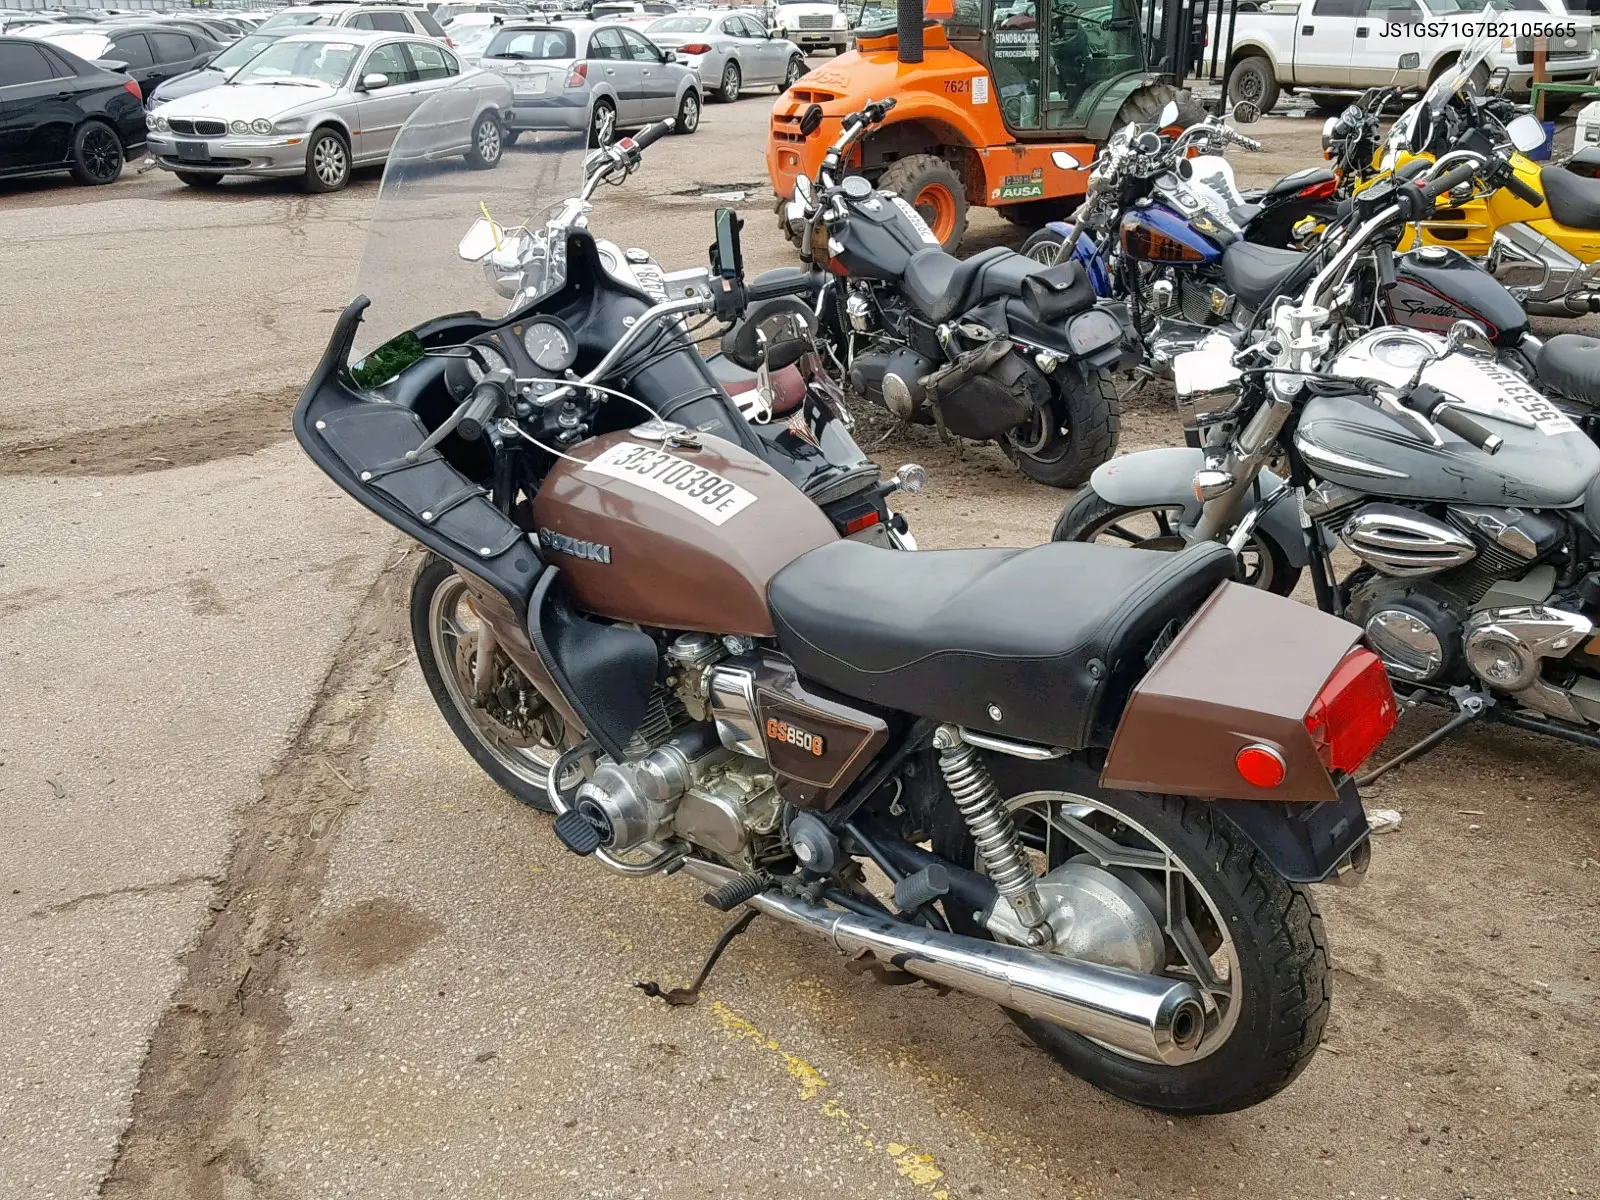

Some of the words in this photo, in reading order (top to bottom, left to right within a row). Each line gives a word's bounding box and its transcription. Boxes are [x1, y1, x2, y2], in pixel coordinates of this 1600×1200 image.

[995, 33, 1014, 44] STAND
[1014, 33, 1029, 44] BACK
[943, 80, 970, 93] 7621
[1002, 186, 1042, 198] AUSA
[1400, 299, 1458, 318] Sportster
[540, 527, 612, 564] SUZUKI
[767, 717, 823, 756] GS850G
